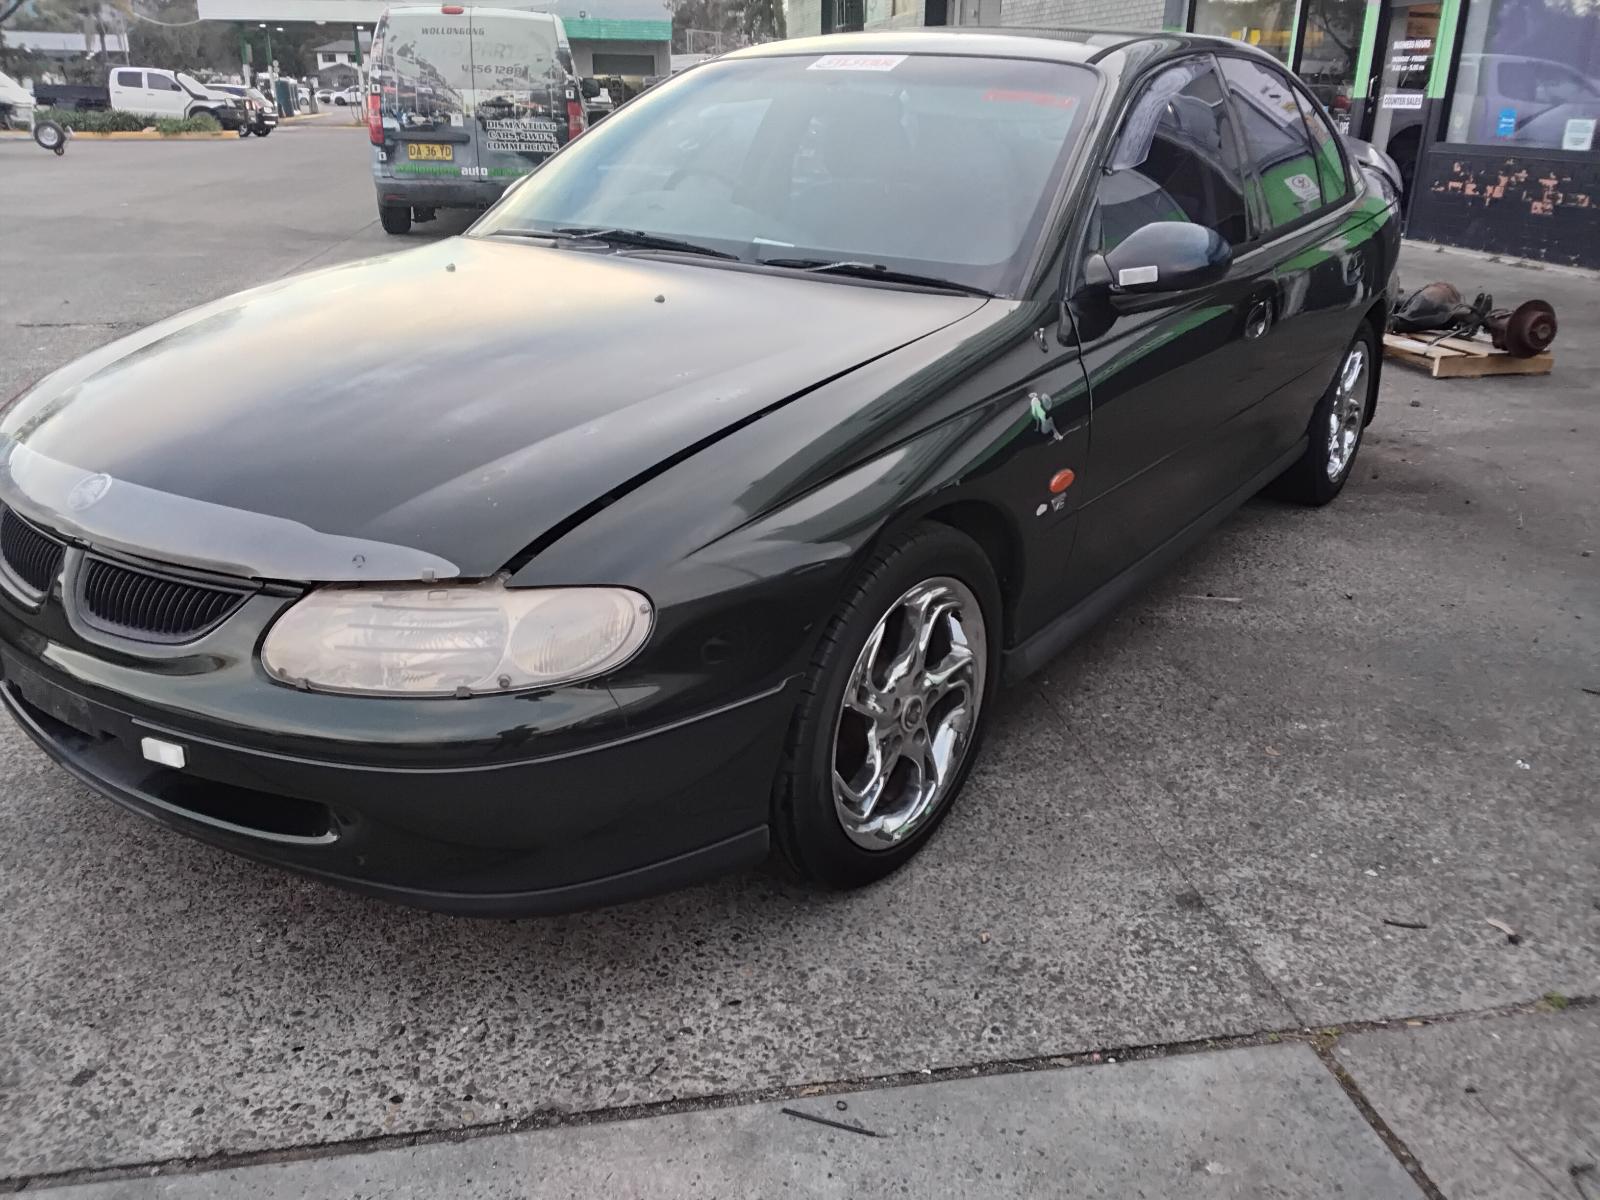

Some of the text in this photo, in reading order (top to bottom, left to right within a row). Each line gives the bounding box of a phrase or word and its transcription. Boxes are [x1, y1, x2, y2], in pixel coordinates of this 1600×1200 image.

[421, 27, 485, 36] WOLLONGONG
[1384, 97, 1421, 105] COUNTER SALES
[487, 120, 557, 131] DISMANTLING
[488, 130, 519, 141] CARS,
[410, 145, 451, 157] DA 36 YD
[487, 141, 560, 152] COMMERCIALS
